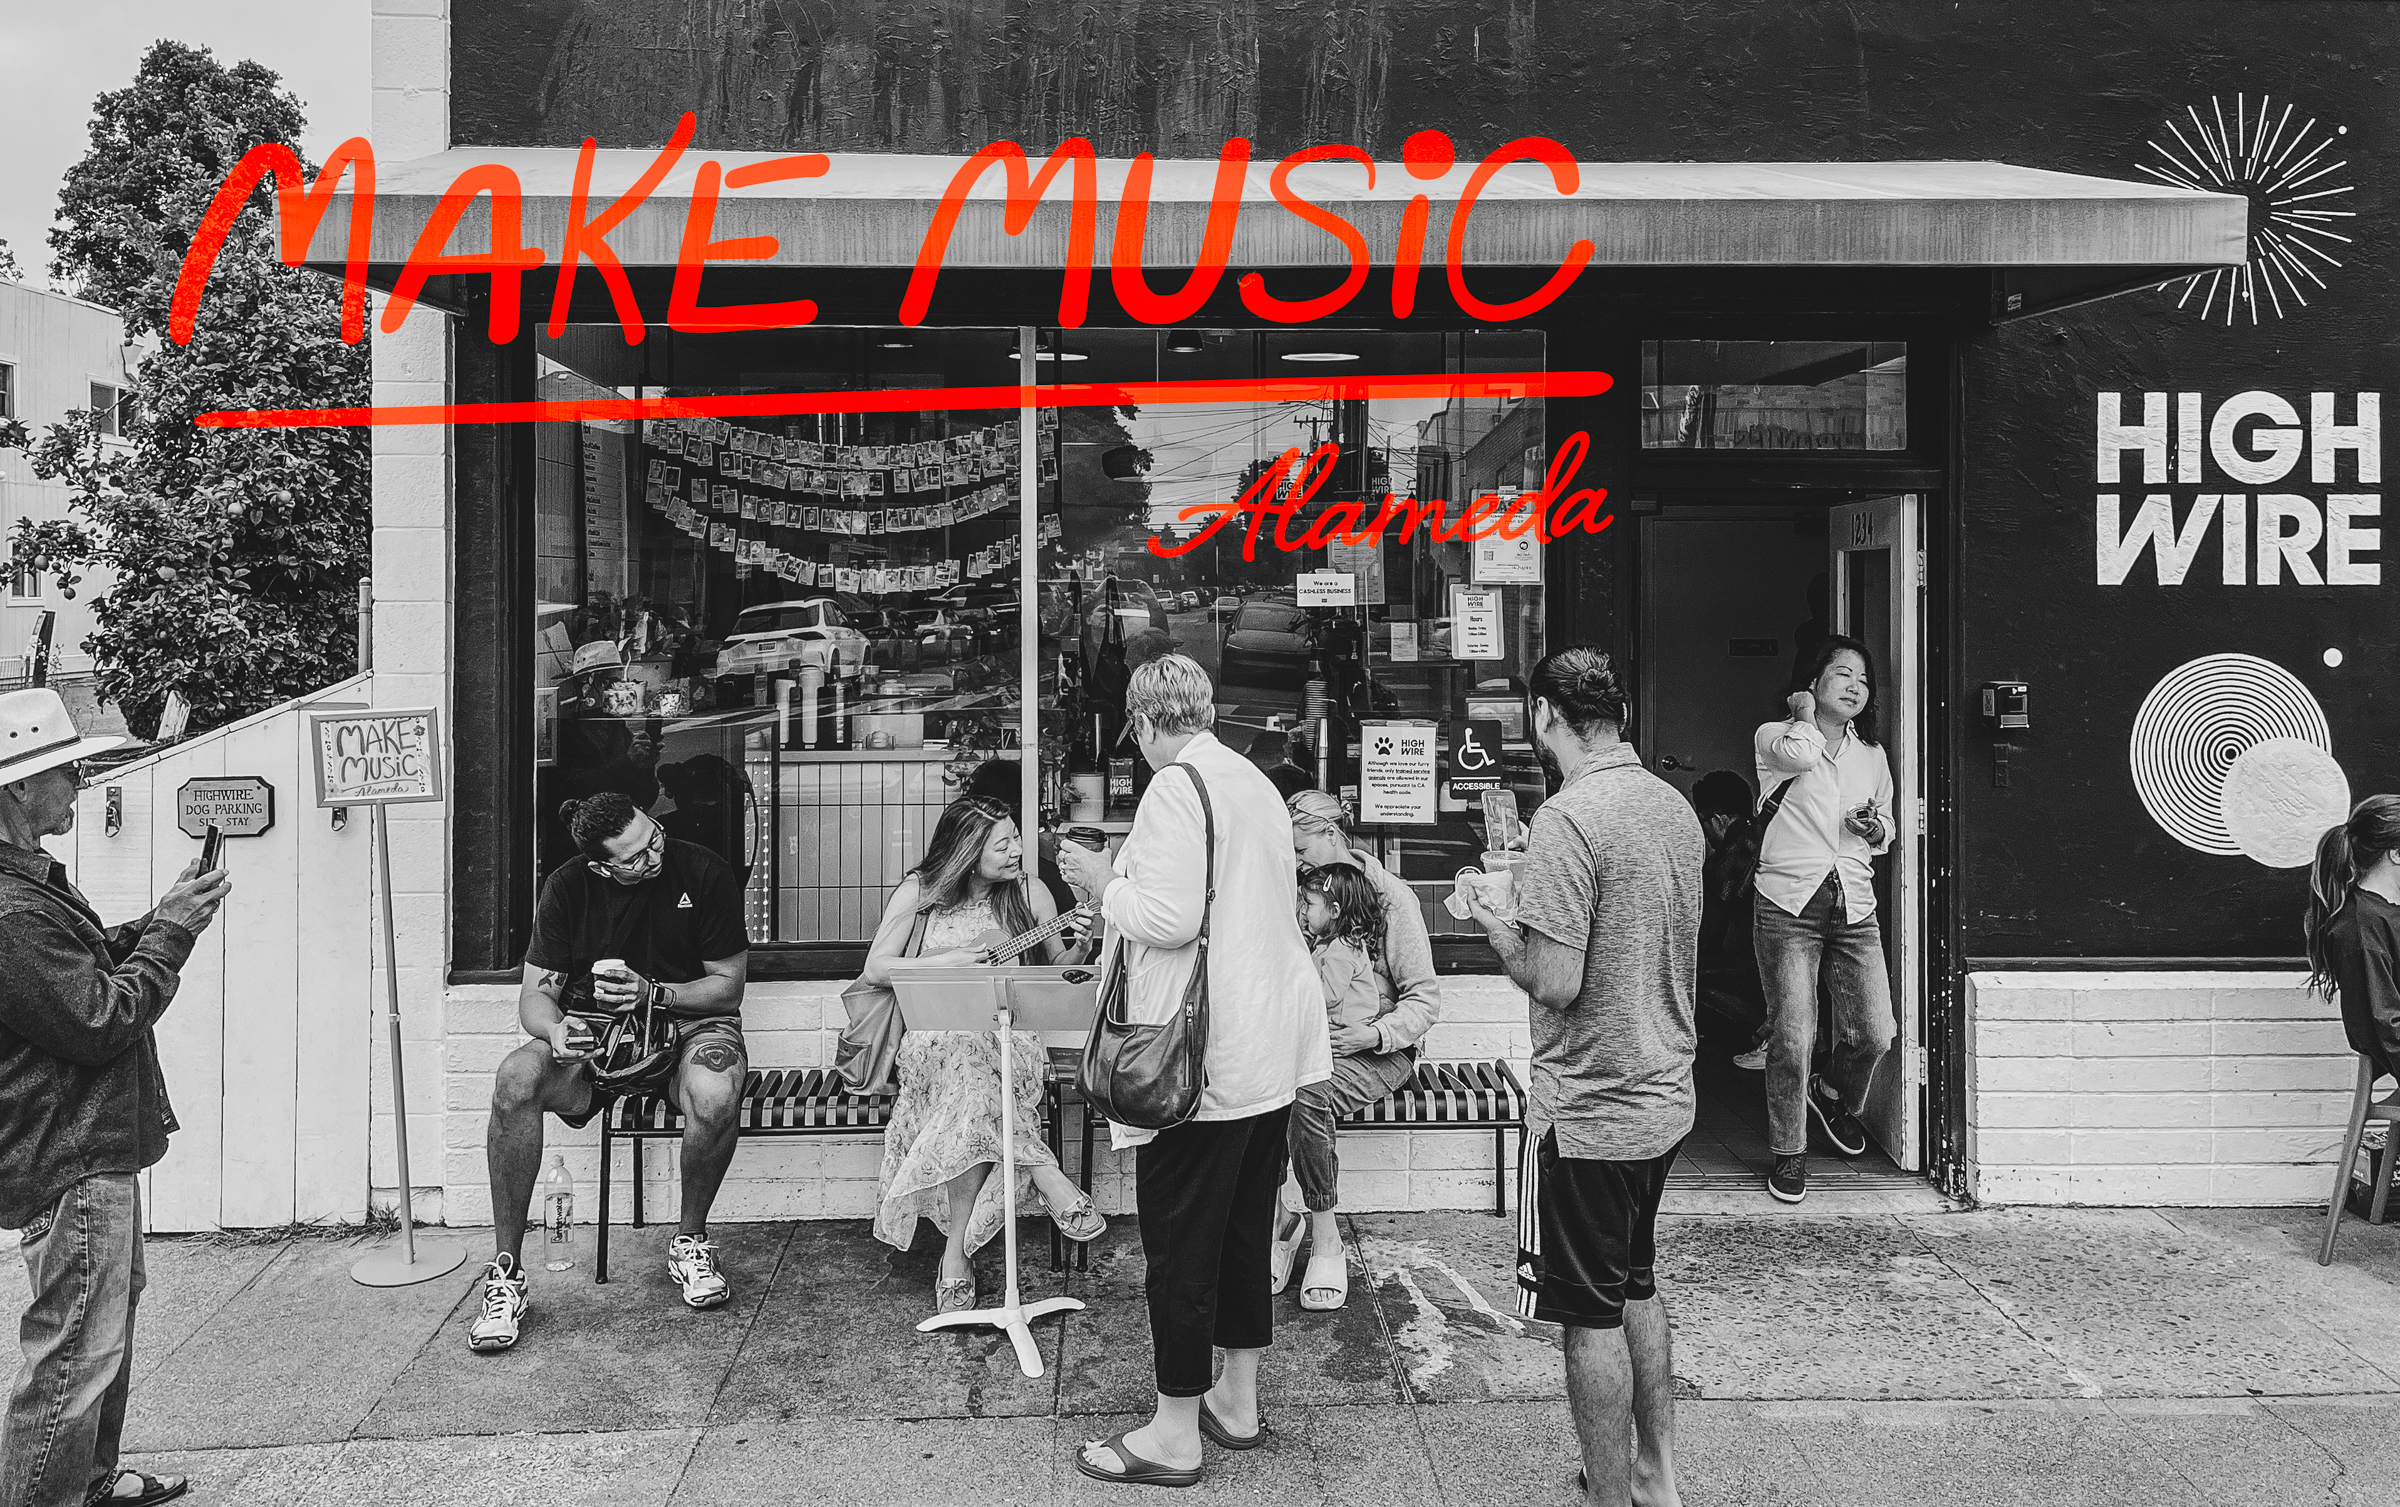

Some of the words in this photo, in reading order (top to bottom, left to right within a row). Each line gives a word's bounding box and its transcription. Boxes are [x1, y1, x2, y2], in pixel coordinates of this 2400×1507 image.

[2096, 391, 2381, 484] HIGH
[2096, 494, 2381, 585] WIRE
[336, 720, 417, 757] MAKE
[1401, 739, 1425, 747] HIGH
[1401, 748, 1425, 756] WIRE
[1110, 778, 1133, 786] HIGH
[193, 789, 254, 801] HIGHWIRE
[355, 782, 409, 797] Alameda
[1110, 786, 1133, 795] WIRE
[186, 804, 210, 815] DOG
[215, 803, 263, 815] PARKING
[199, 818, 217, 827] SIT
[226, 817, 249, 826] STAY
